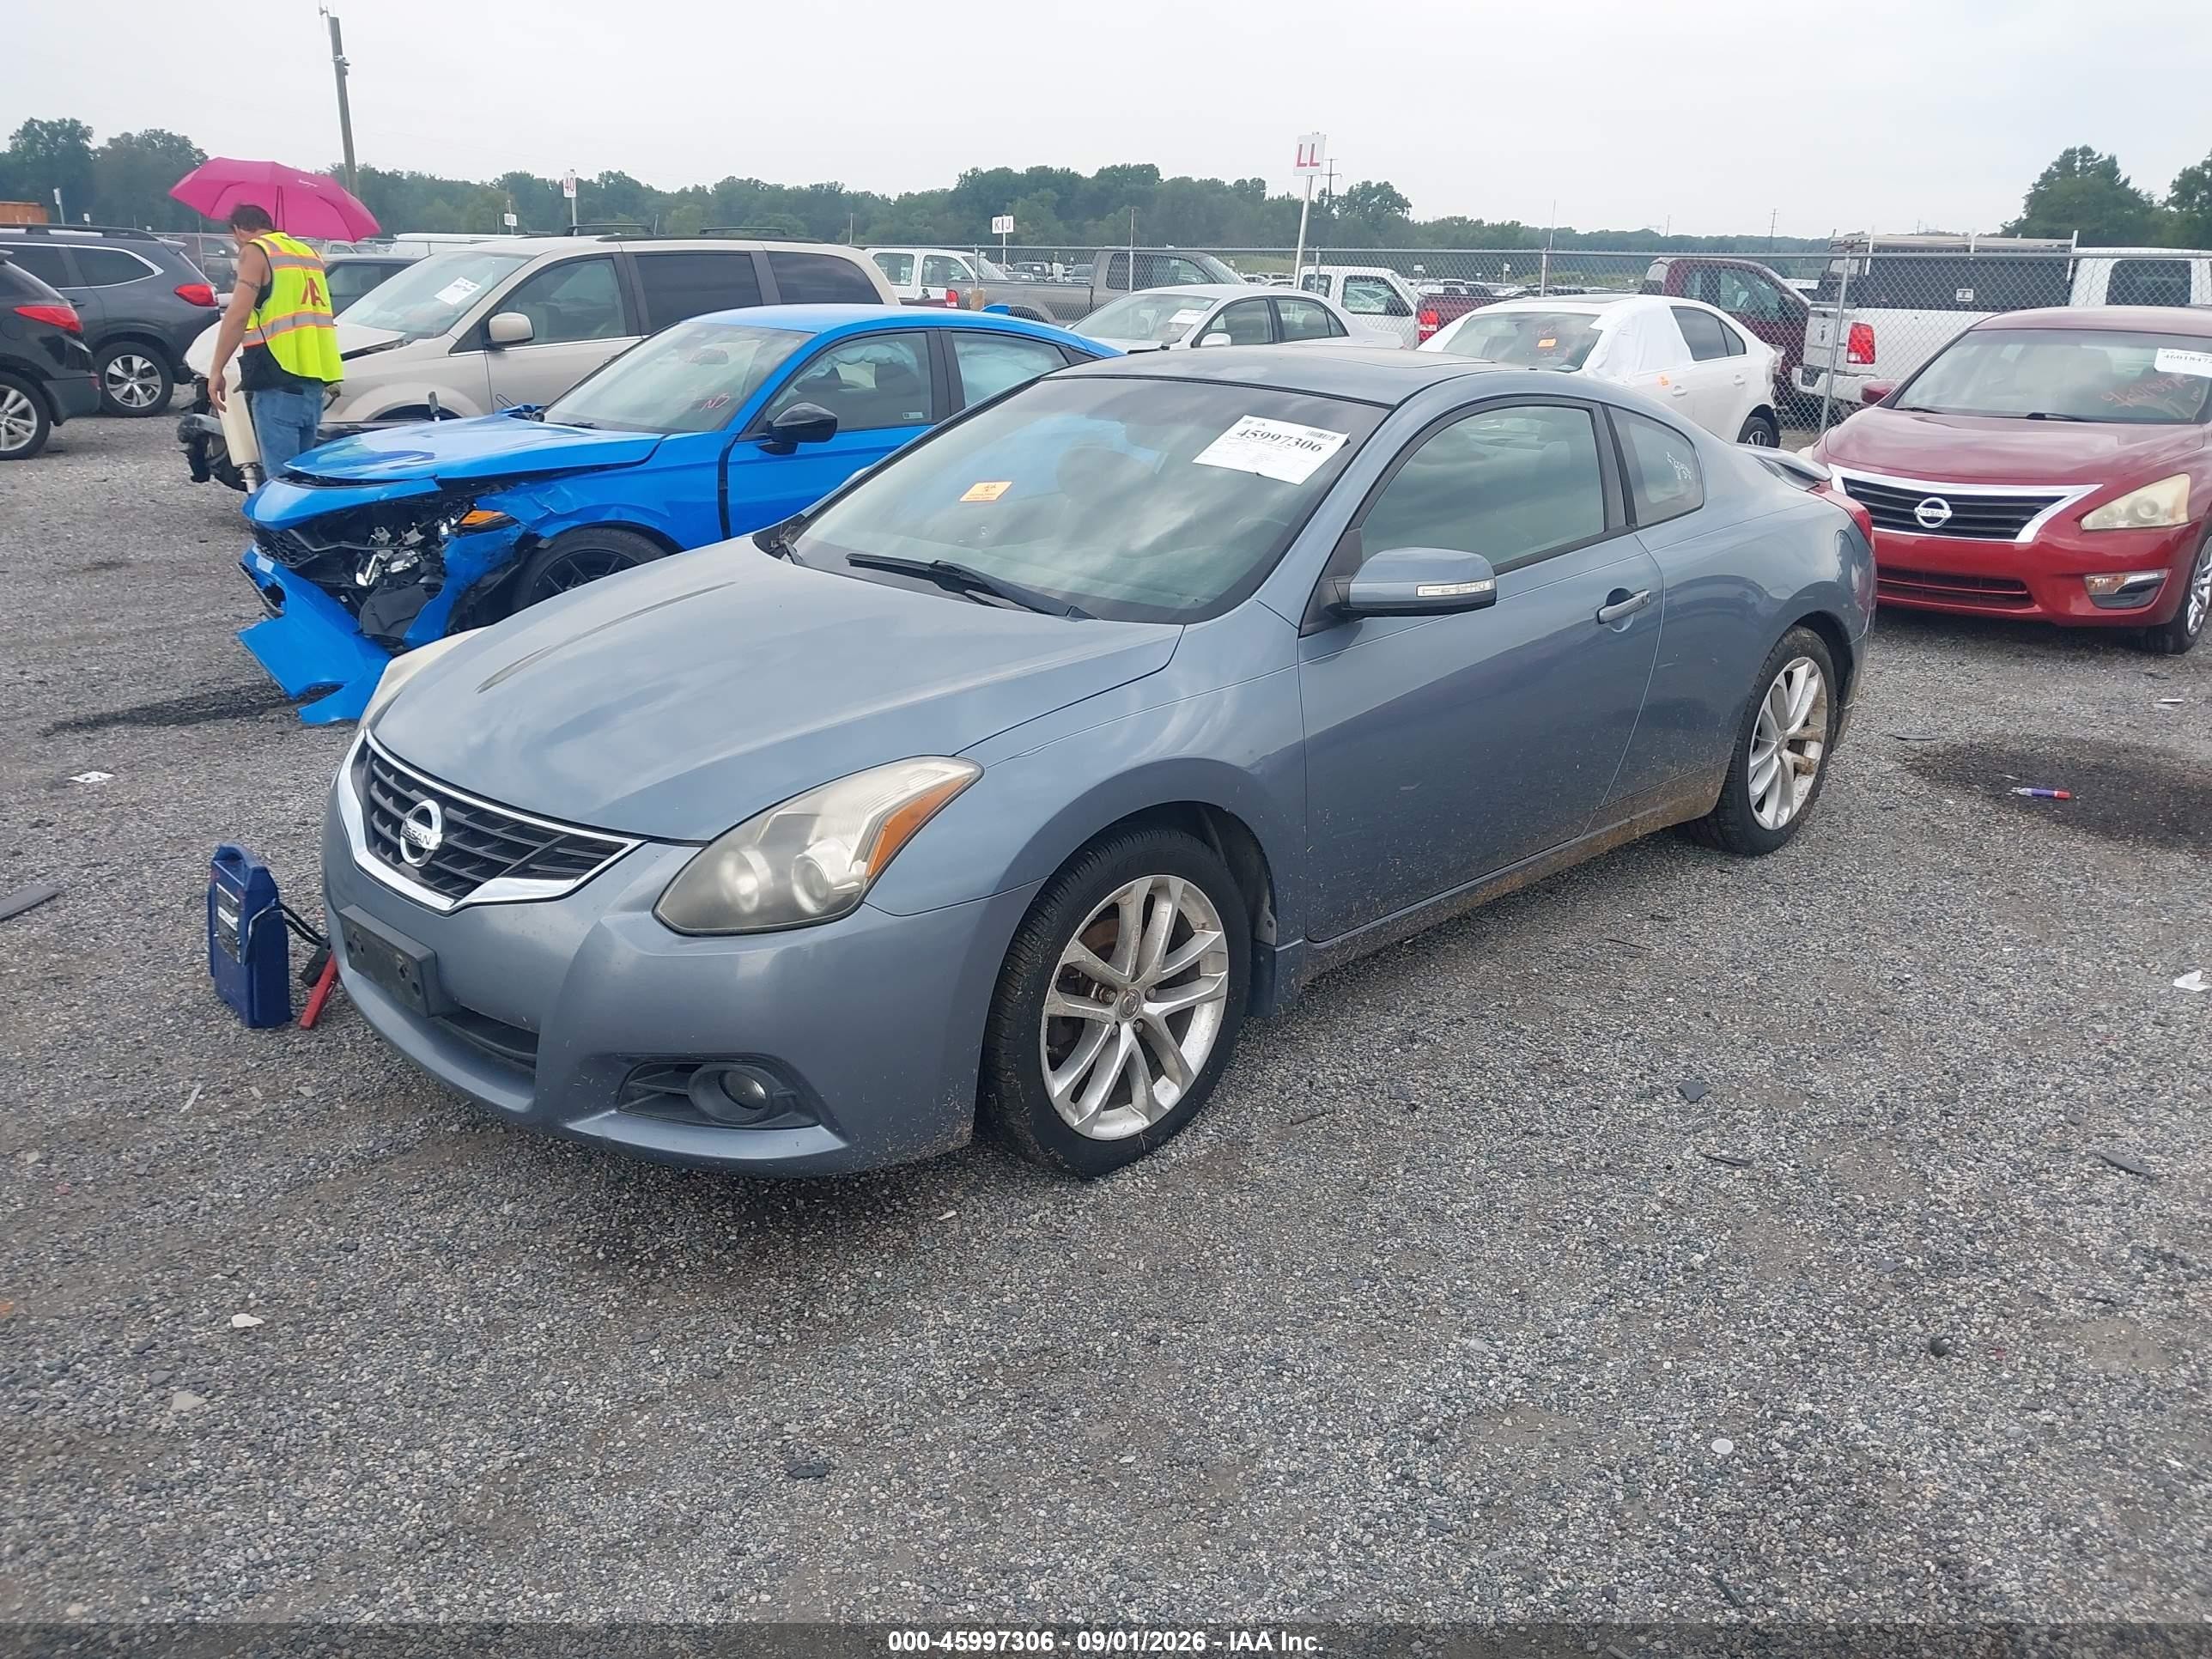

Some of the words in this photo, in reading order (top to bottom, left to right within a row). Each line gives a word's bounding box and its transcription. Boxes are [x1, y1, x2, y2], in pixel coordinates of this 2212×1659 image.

[1297, 143, 1320, 167] LL
[565, 177, 574, 192] 40
[1236, 428, 1327, 453] 45997306
[1917, 508, 1948, 517] NISSAN
